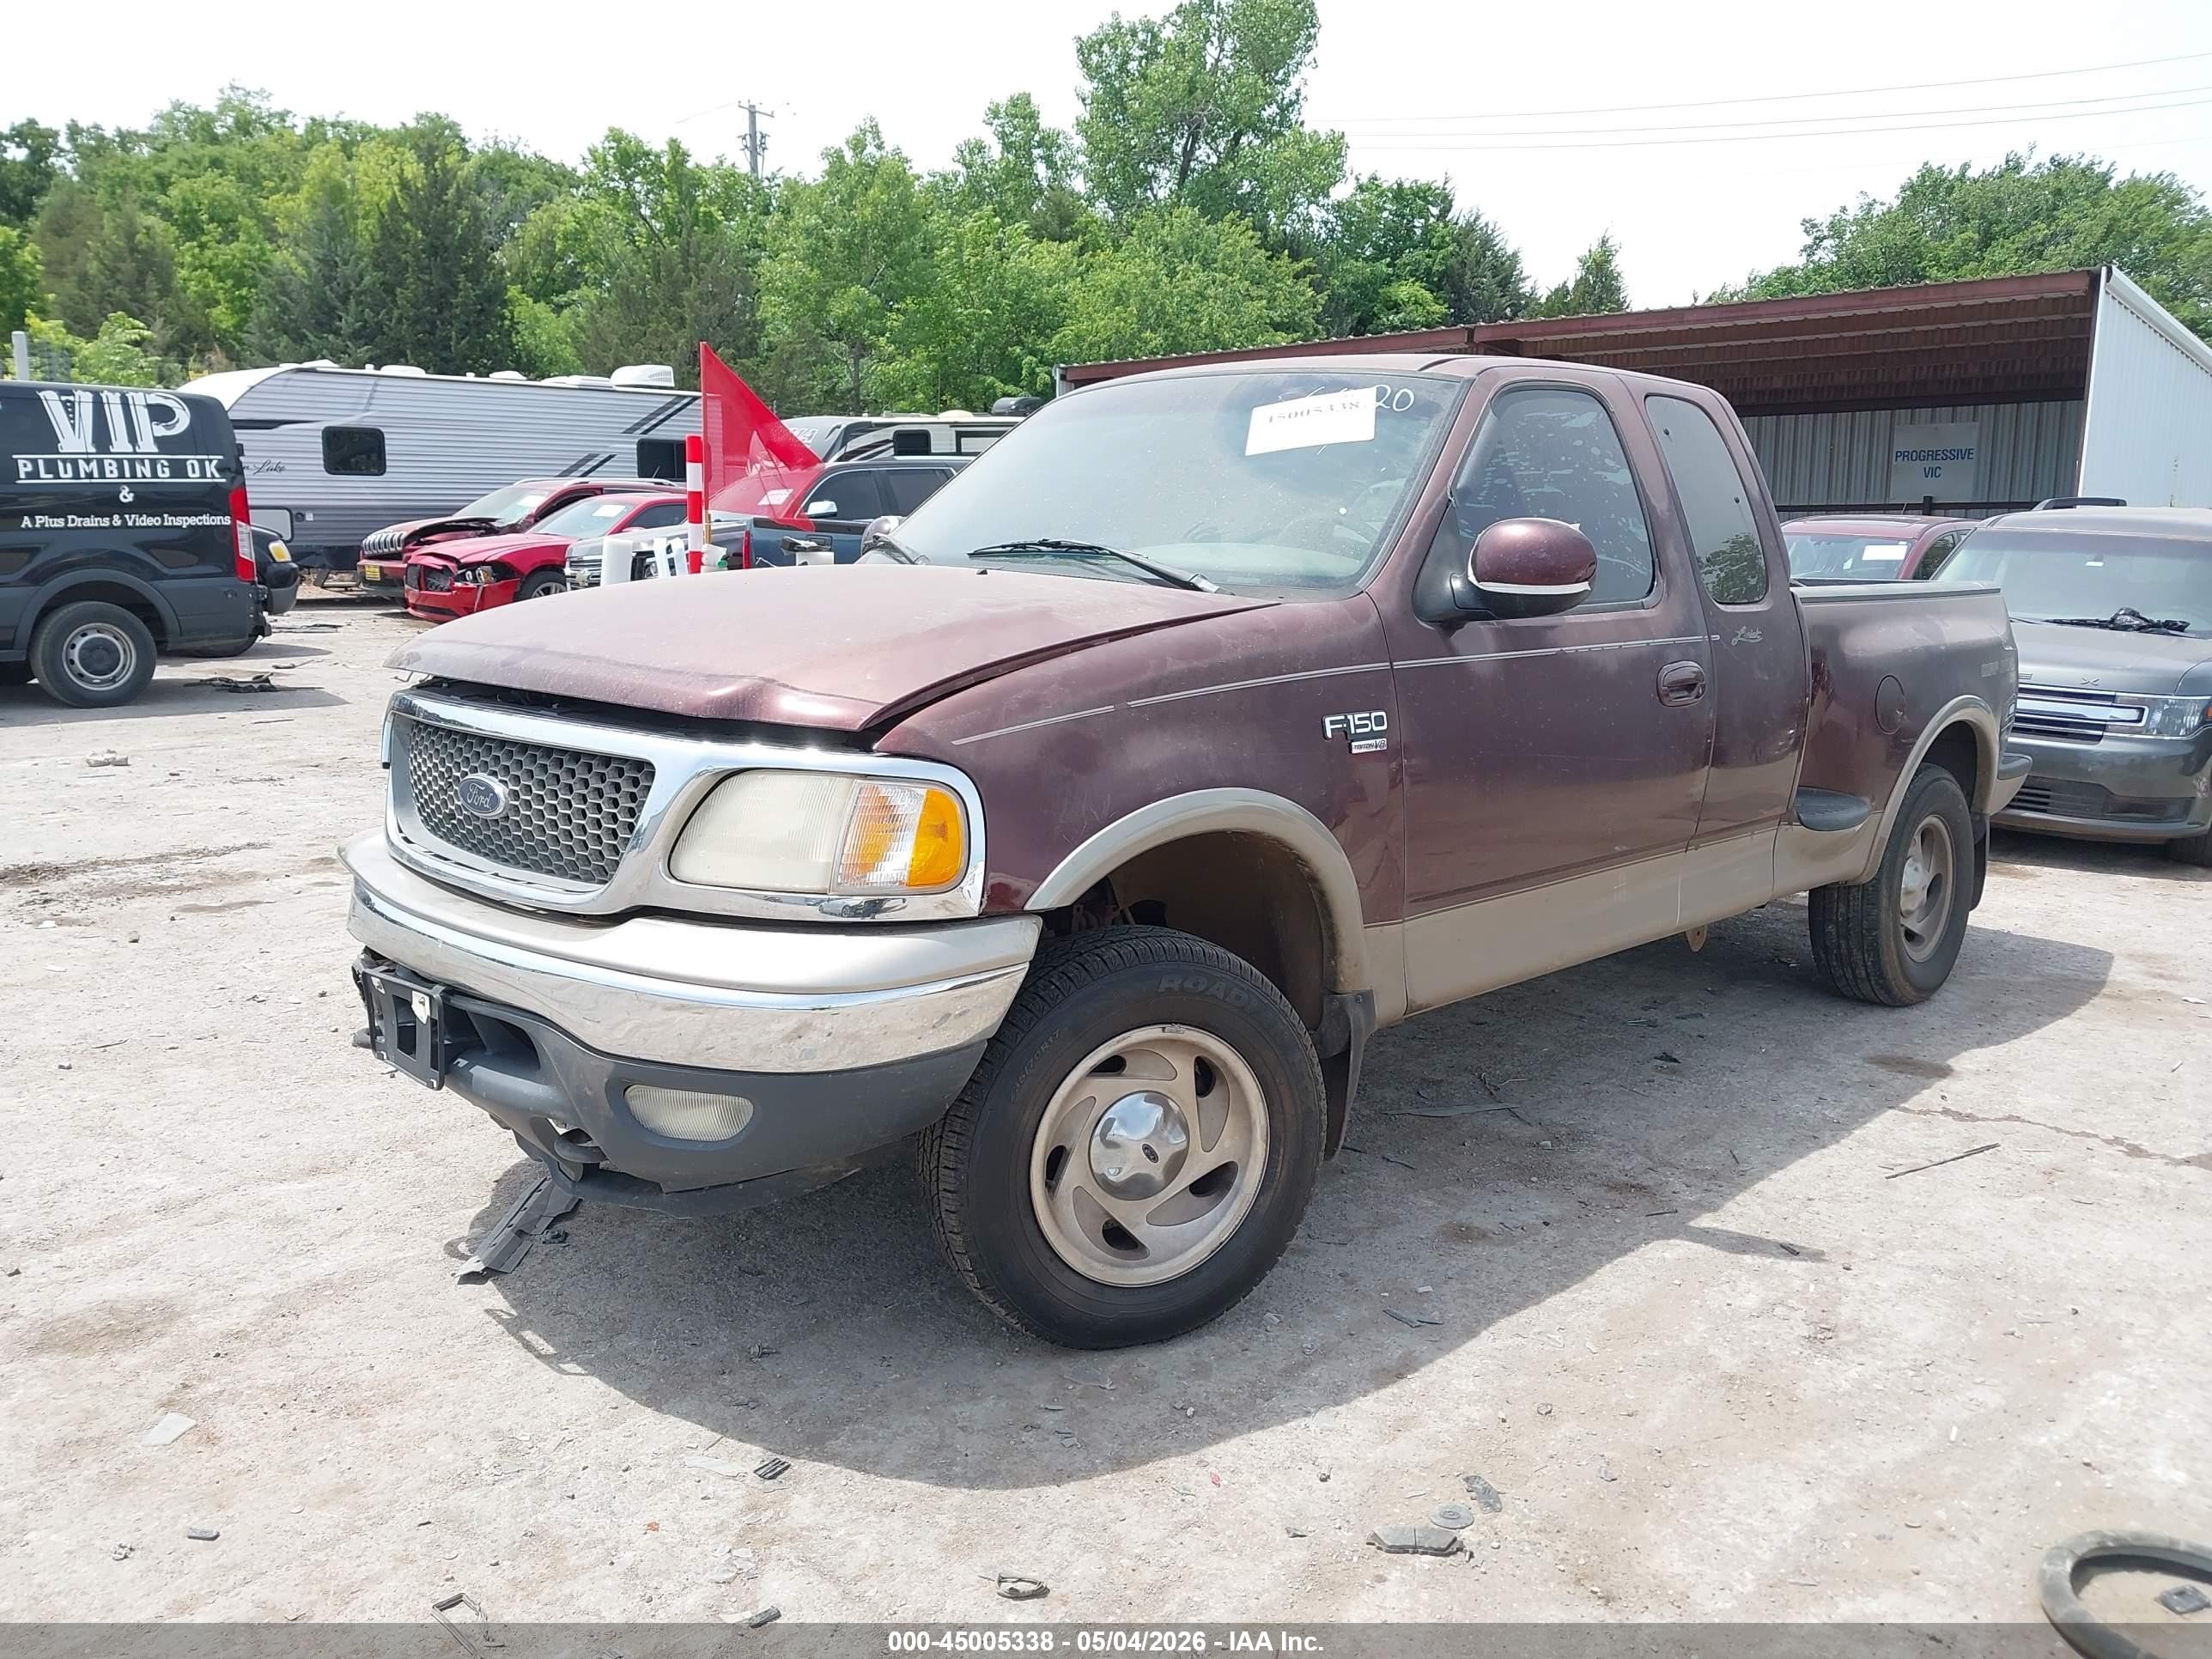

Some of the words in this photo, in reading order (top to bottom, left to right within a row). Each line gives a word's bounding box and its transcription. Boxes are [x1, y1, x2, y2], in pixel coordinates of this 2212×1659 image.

[36, 390, 191, 453] VIP
[1895, 448, 1975, 462] PROGRESSIVE
[17, 459, 171, 479] PLUMBING
[186, 459, 222, 479] OK
[1923, 466, 1942, 478] VIC
[118, 485, 135, 503] &
[21, 515, 33, 528] A
[34, 515, 65, 528] Plus
[67, 514, 111, 527] Drains
[112, 514, 122, 526] &
[124, 514, 161, 526] Video
[163, 513, 231, 528] Inspections
[467, 781, 494, 810] Ford
